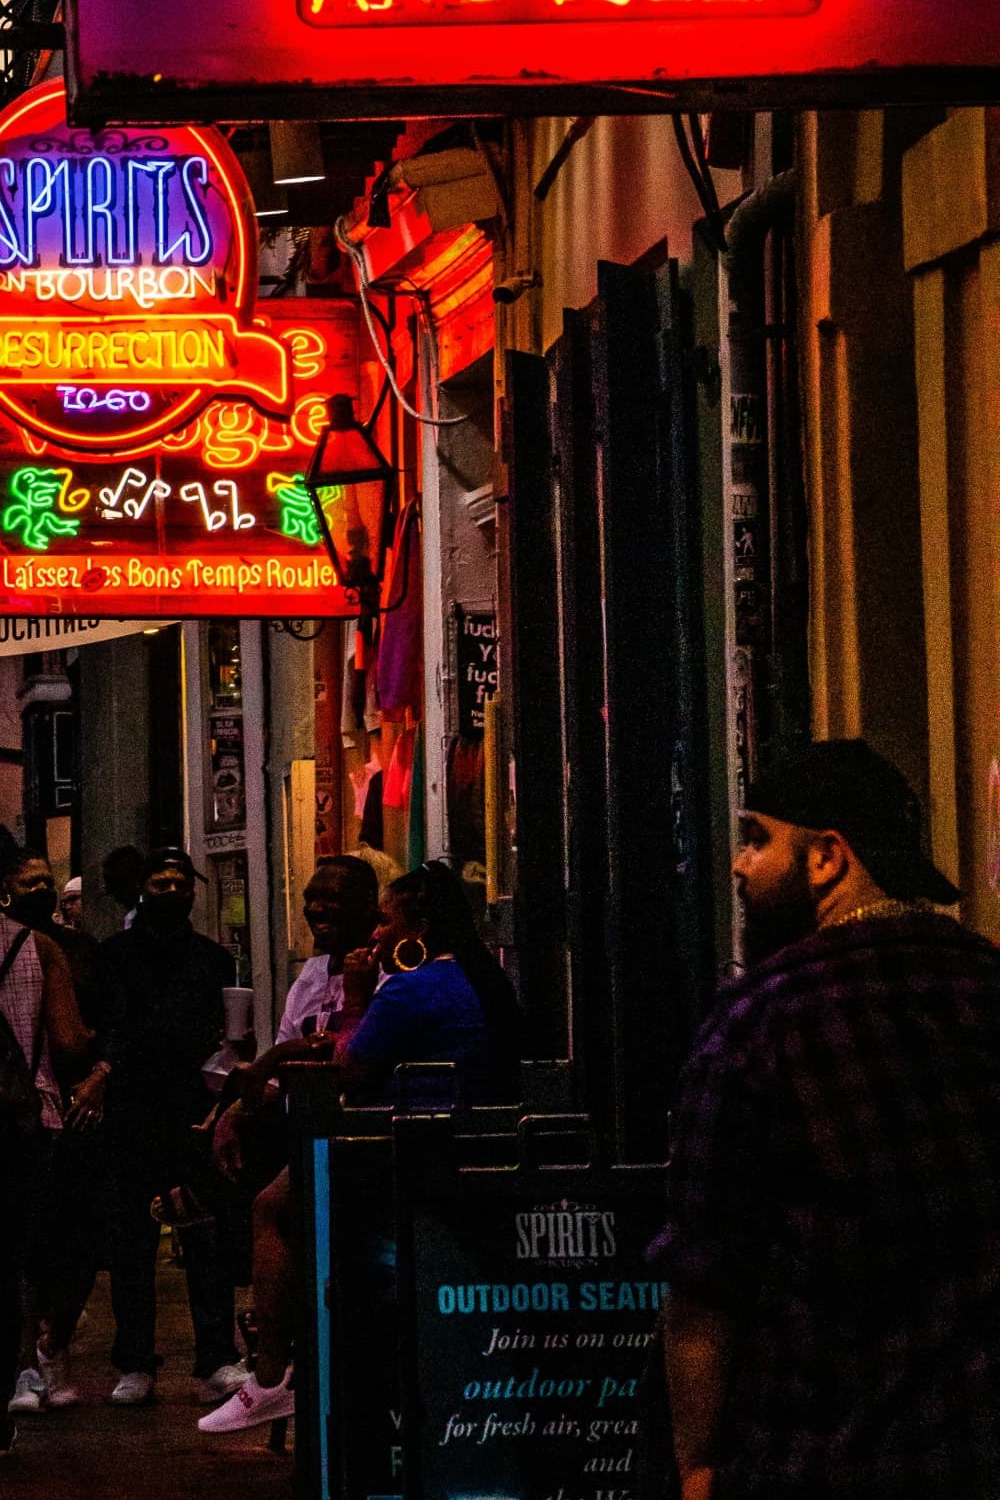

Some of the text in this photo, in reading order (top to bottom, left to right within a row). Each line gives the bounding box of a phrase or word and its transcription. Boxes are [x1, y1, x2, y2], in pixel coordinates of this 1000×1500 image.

[34, 266, 218, 309] BOURBON
[127, 557, 183, 589] Bons
[186, 558, 263, 593] Temps
[514, 1211, 617, 1259] SPIRITS
[436, 1282, 570, 1314] OUTDOOR
[481, 1328, 656, 1357] Join us on our
[463, 1364, 594, 1402] outdoor
[438, 1412, 480, 1447] for
[477, 1411, 536, 1445] fresh
[542, 1411, 582, 1438] air,
[583, 1447, 633, 1474] and
